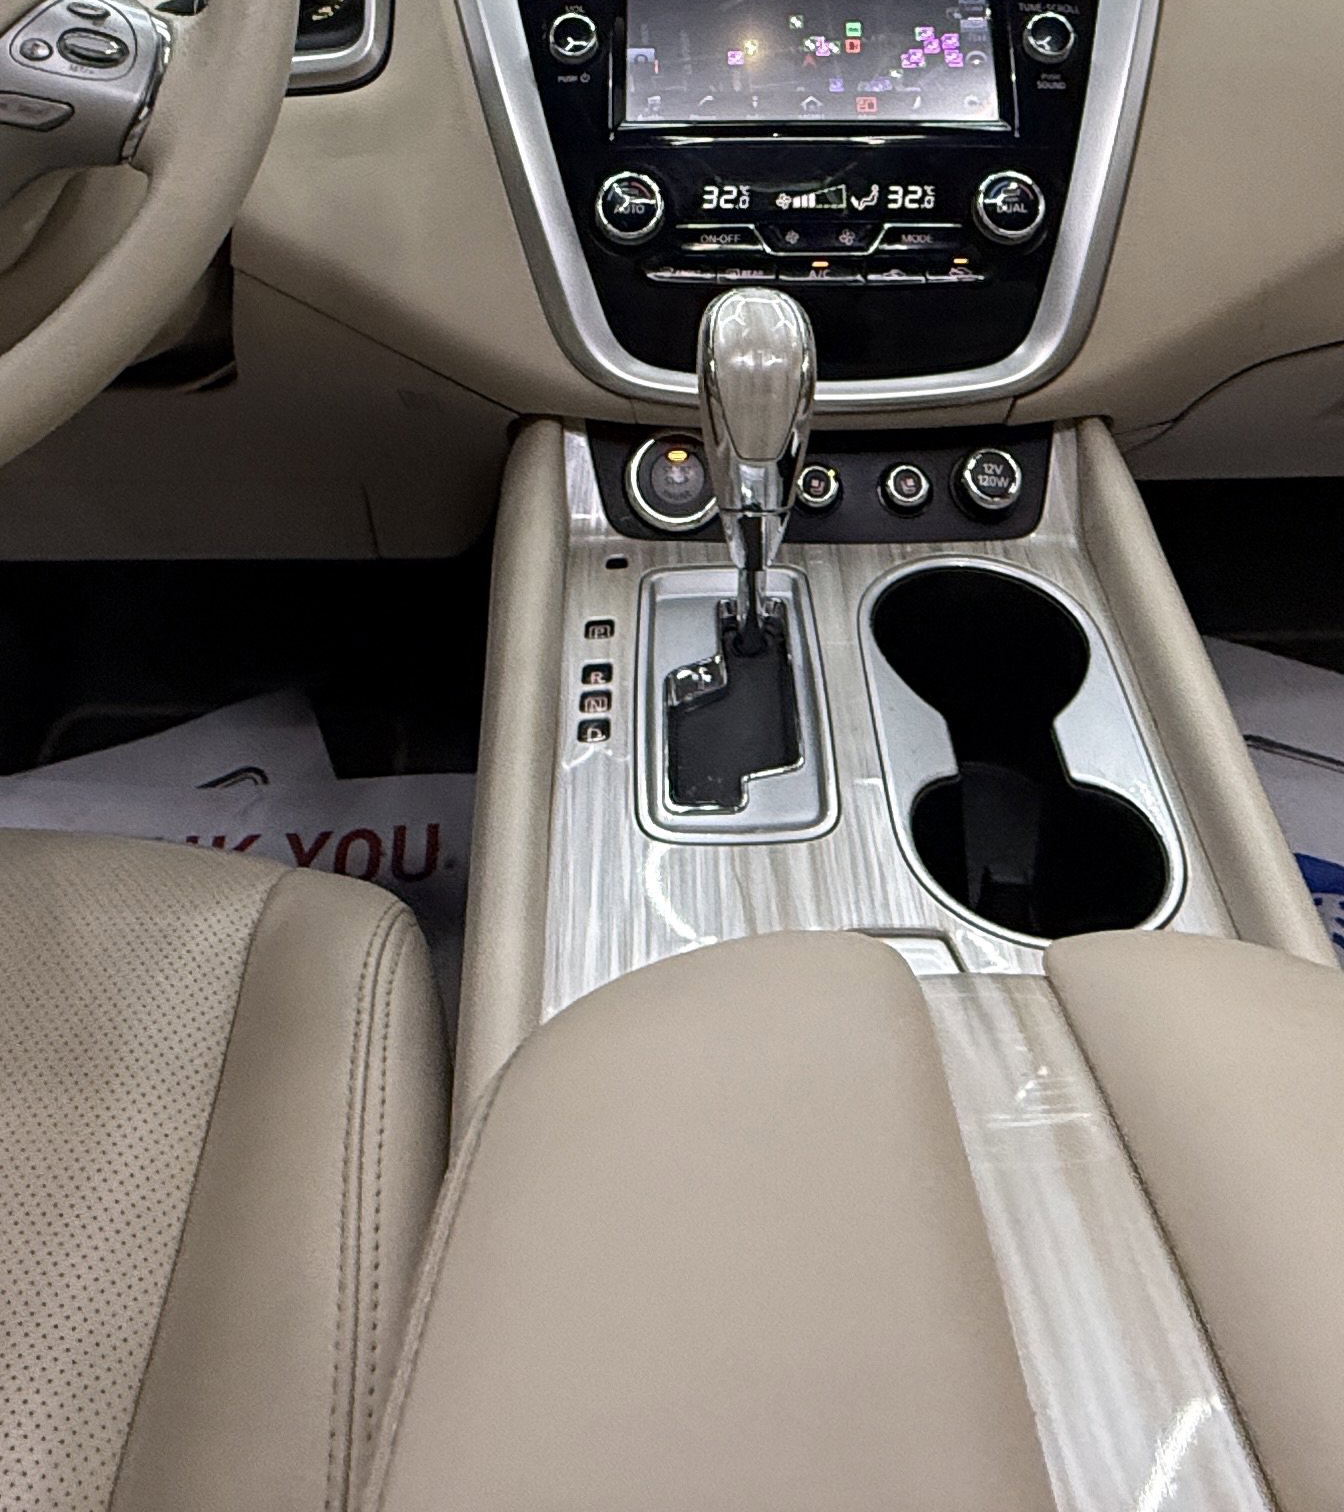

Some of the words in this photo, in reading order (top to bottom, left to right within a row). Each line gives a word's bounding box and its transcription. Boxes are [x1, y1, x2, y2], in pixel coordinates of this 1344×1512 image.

[613, 204, 645, 214] AUTO
[996, 203, 1028, 213] DUAL
[901, 234, 933, 243] MODE
[809, 269, 830, 280] A/C
[982, 463, 1004, 475] 12V
[977, 474, 1009, 488] 120W
[285, 823, 441, 883] YOU
